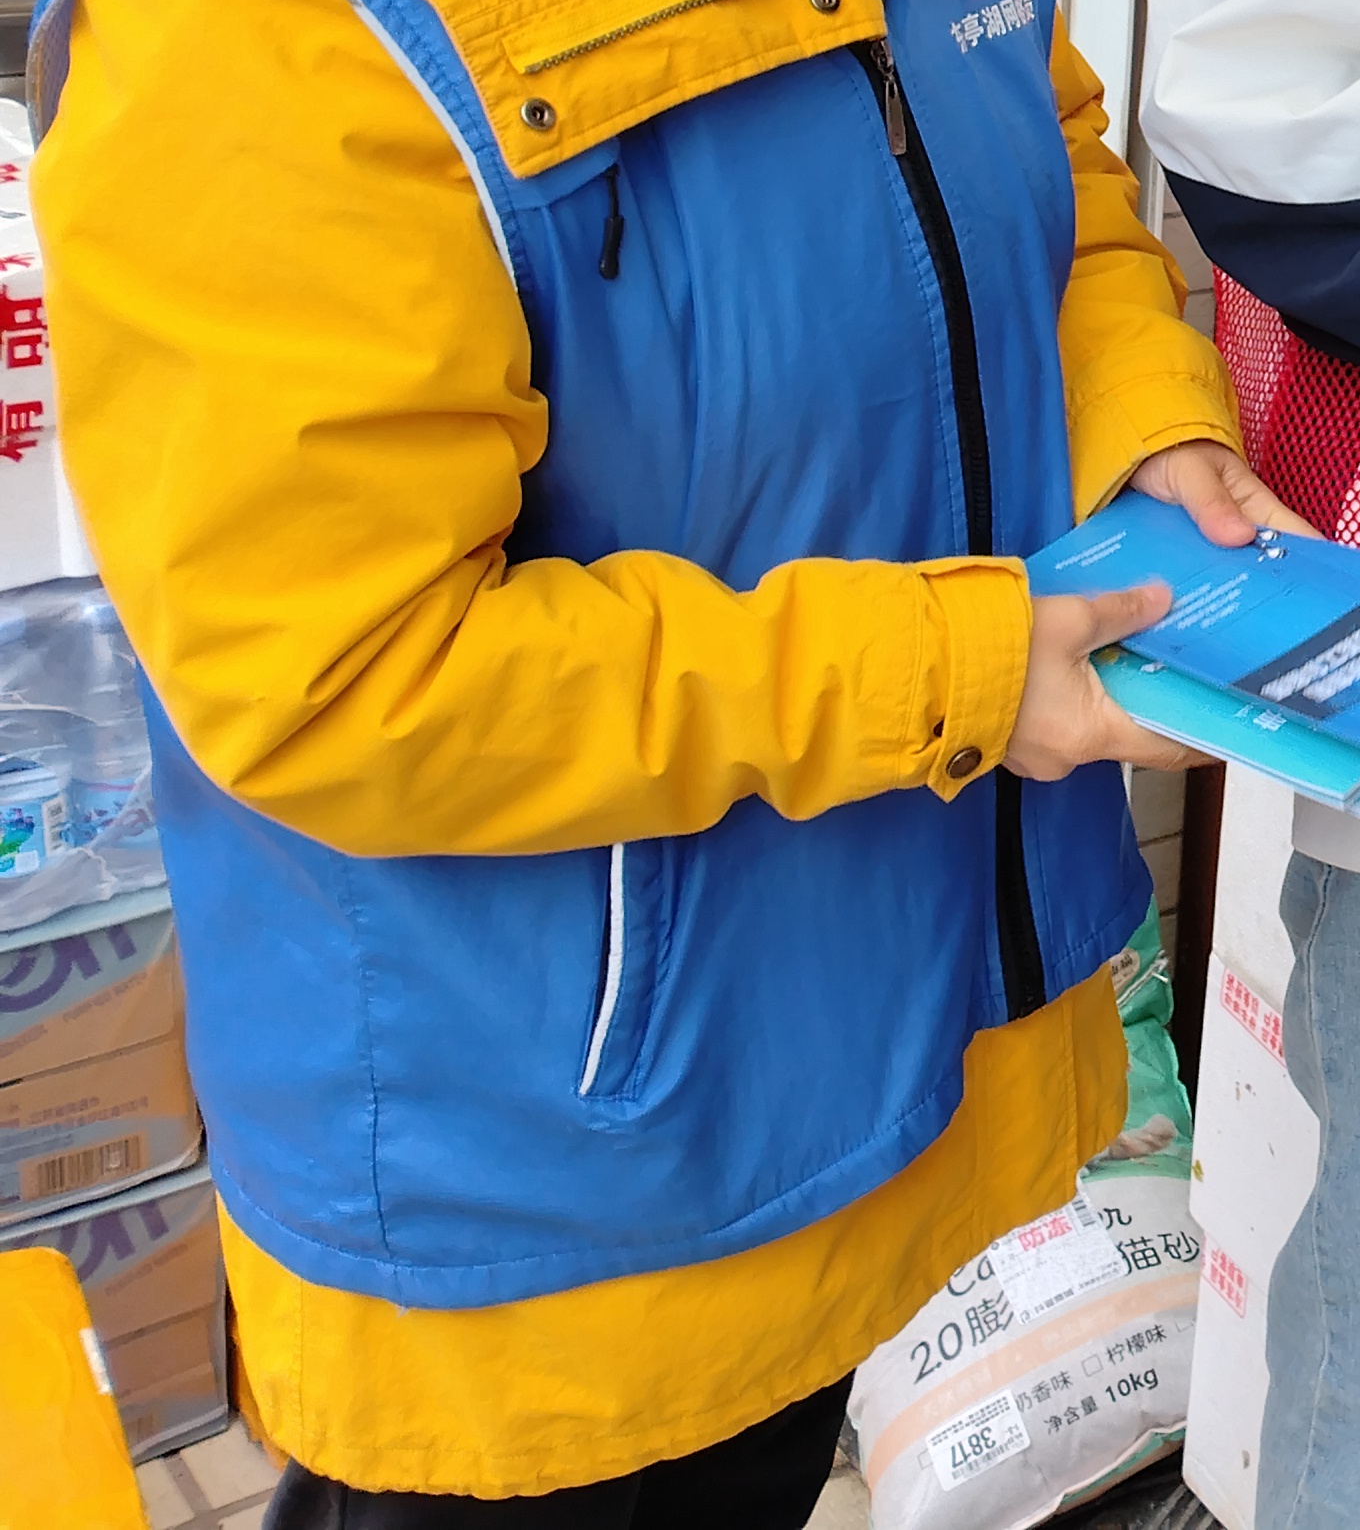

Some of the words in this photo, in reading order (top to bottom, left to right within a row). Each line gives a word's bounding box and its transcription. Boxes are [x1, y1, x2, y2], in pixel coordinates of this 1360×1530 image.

[1017, 1214, 1073, 1253] 防冻
[1114, 1230, 1200, 1276] 猫砂
[1106, 1324, 1168, 1366] 柠檬味
[1043, 1395, 1099, 1435] 净含量
[1105, 1367, 1159, 1403] 10kg
[949, 1426, 998, 1469] 3817
